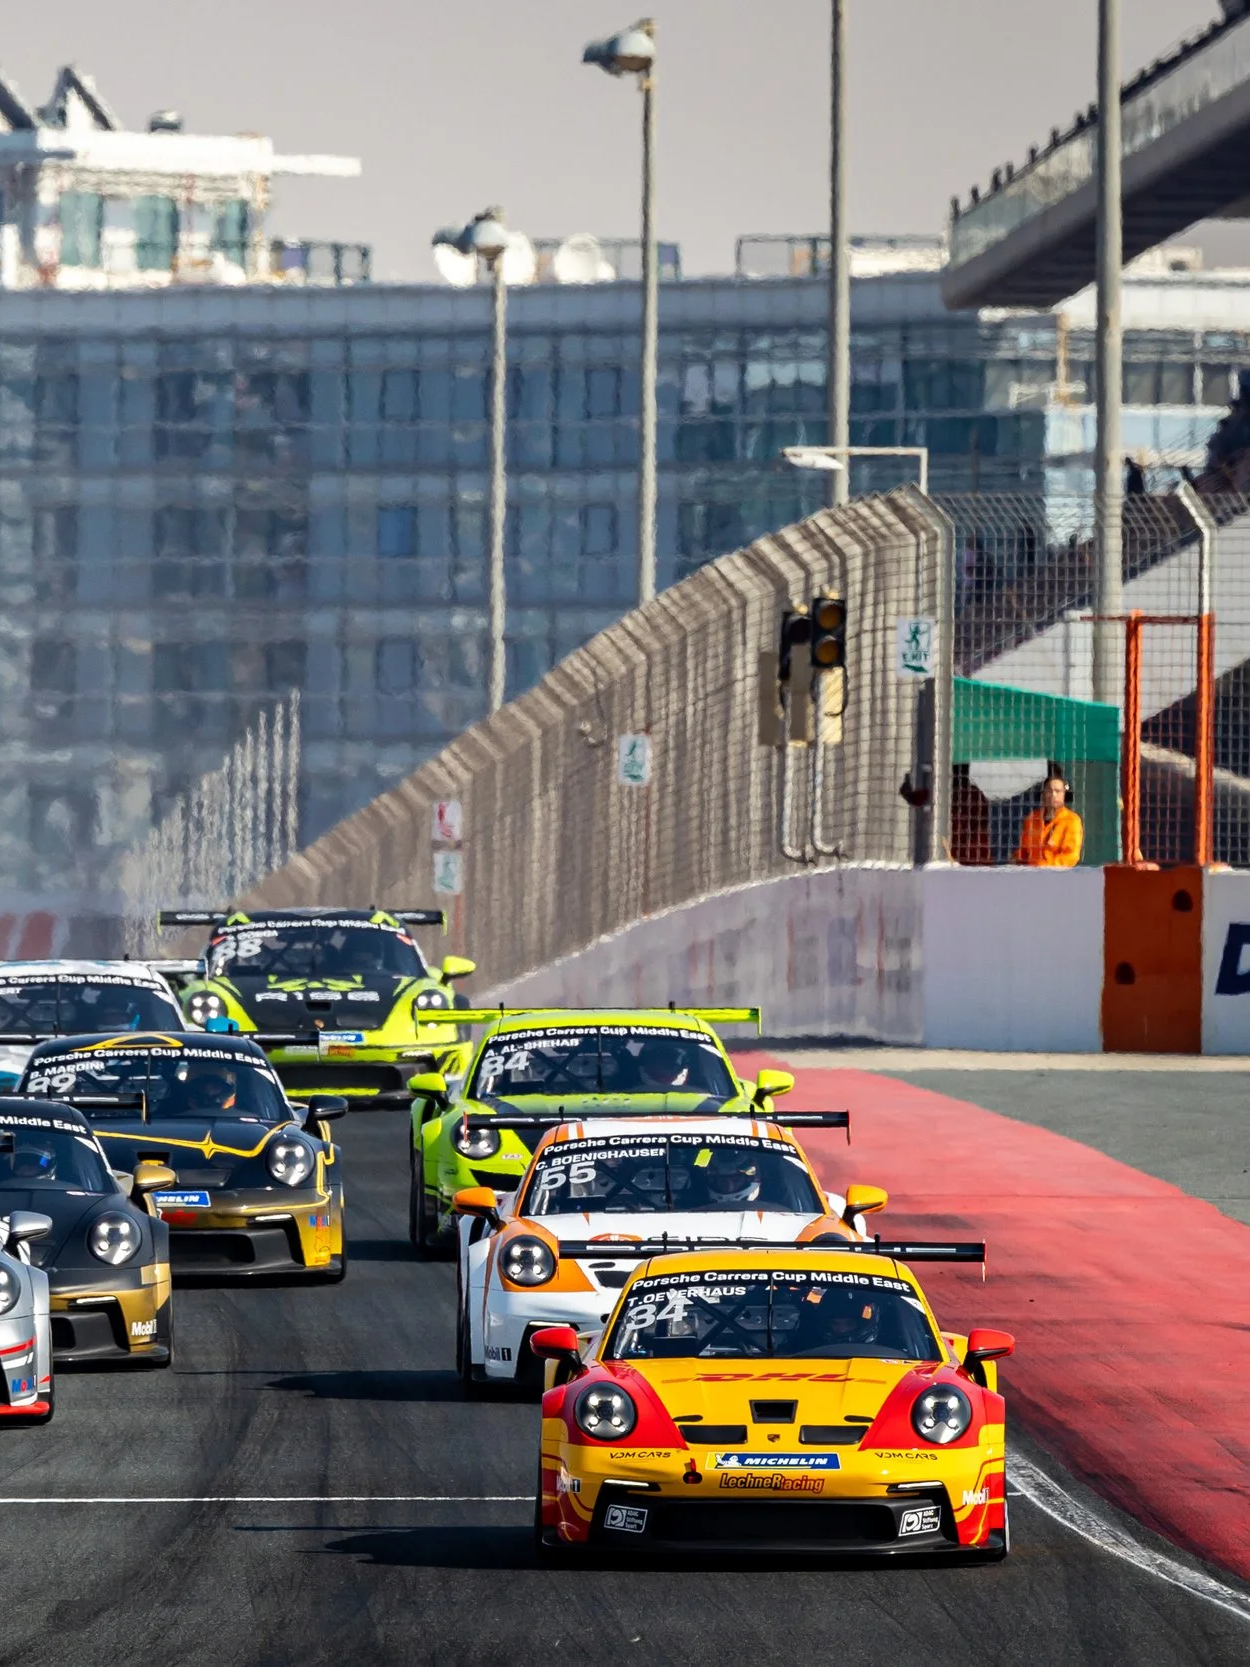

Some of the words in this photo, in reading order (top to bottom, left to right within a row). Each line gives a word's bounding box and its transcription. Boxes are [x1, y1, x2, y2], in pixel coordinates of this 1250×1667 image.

[488, 1030, 543, 1044] Porsche
[546, 1026, 598, 1036] Carrera
[600, 1026, 628, 1037] Cup
[630, 1026, 679, 1038] Middle
[680, 1030, 712, 1043] East
[34, 1052, 91, 1067] Porsche
[93, 1048, 149, 1058] Carrera
[151, 1047, 181, 1058] Cup
[183, 1048, 232, 1060] Middle
[235, 1053, 267, 1067] East
[480, 1050, 530, 1078] 84
[0, 1115, 50, 1128] Middle
[53, 1120, 87, 1134] East
[544, 1138, 607, 1156] Porsche
[609, 1135, 668, 1146] Carrera
[670, 1135, 703, 1147] Cup
[705, 1135, 760, 1148] Middle
[762, 1139, 797, 1154] East
[540, 1160, 597, 1190] 55
[632, 1273, 700, 1291] Porsche
[704, 1271, 768, 1282] Carrera
[771, 1271, 807, 1283] Cup
[810, 1272, 870, 1285] Middle
[872, 1276, 911, 1293] East
[692, 1371, 854, 1383] DHL
[744, 1457, 829, 1466] MICHELIN
[719, 1473, 825, 1493] LechneRacing
